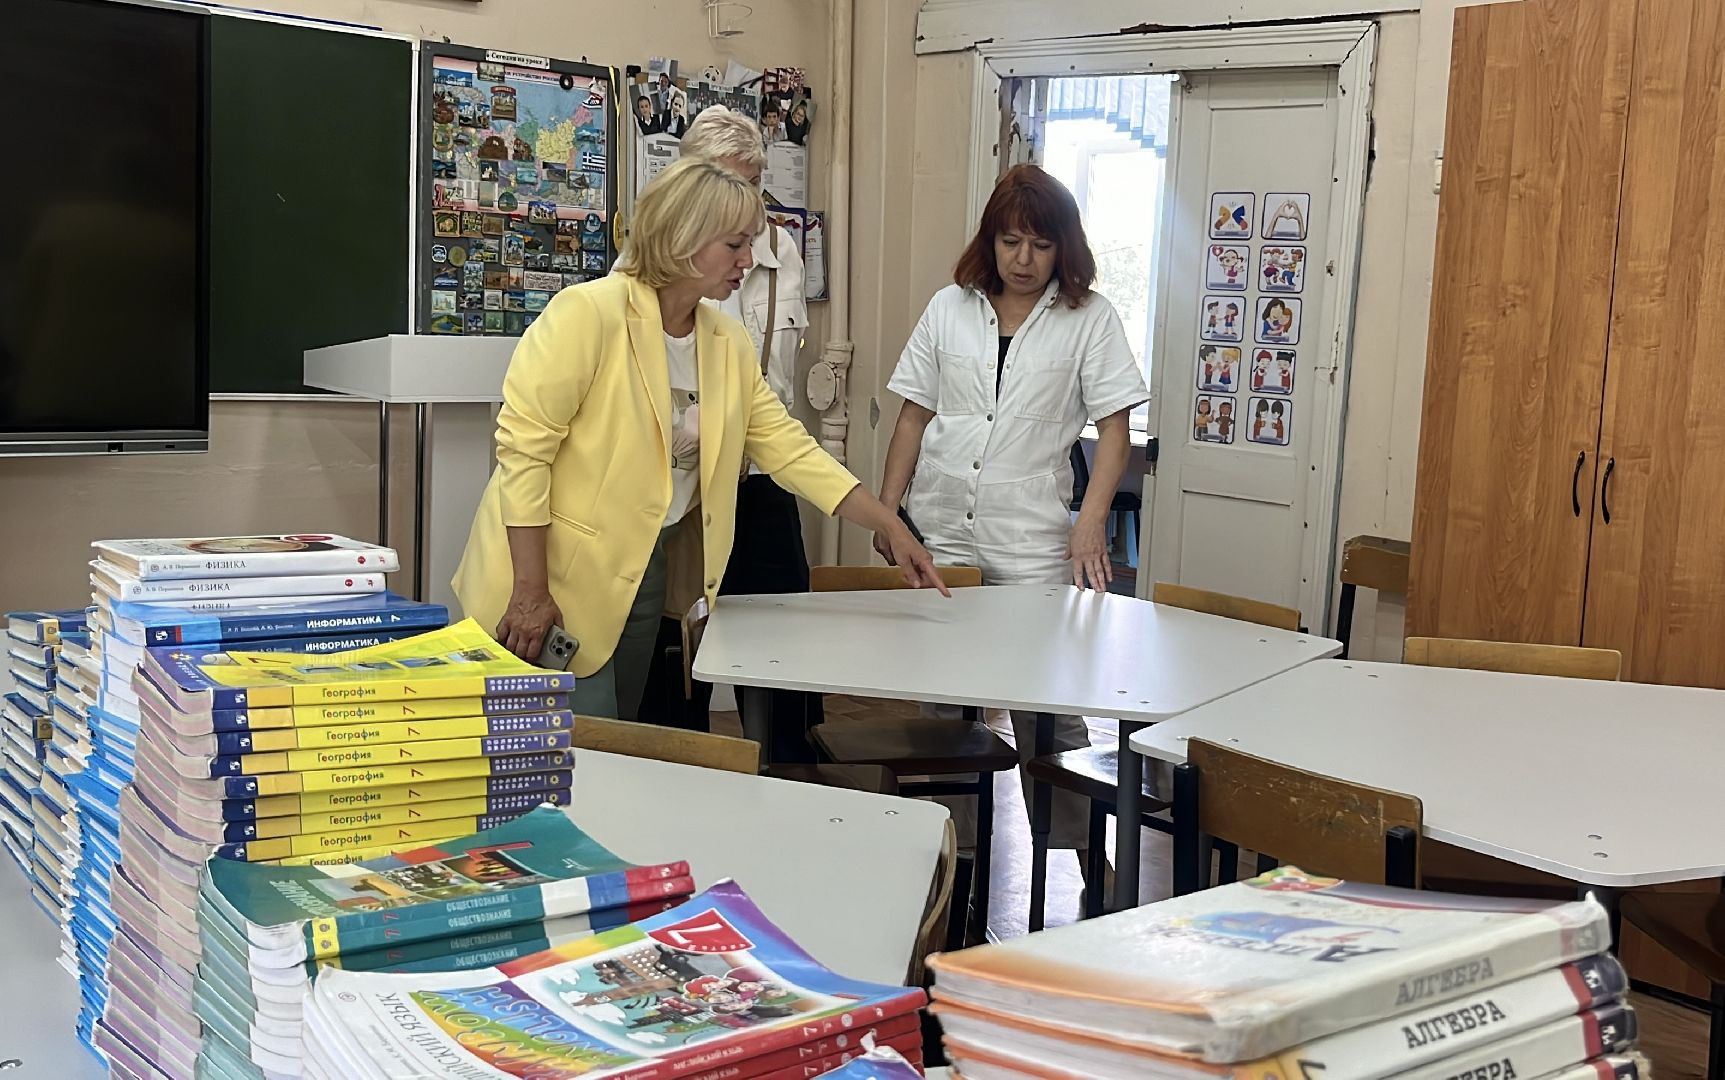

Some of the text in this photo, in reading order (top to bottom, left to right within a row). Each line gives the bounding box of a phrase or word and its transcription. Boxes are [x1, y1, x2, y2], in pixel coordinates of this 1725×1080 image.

[491, 52, 517, 61] Сегодня
[526, 58, 543, 66] уроке
[206, 560, 246, 569] ФИЗИКА
[189, 584, 230, 592] ФИЗИКА
[306, 616, 382, 628] ИНФОРМАТИКА
[306, 638, 380, 652] ИНФОРМАТИКА
[322, 685, 416, 698] География 7
[322, 706, 416, 718] География 7
[492, 717, 543, 725] ПОЛЯРНАЯ
[326, 727, 420, 740] География 7
[486, 737, 539, 745] ПОЛЯРНАЯ
[318, 748, 412, 763] География 7
[331, 768, 424, 783] География 7
[329, 788, 421, 805] География 7
[329, 809, 421, 826] География 7
[320, 830, 411, 847] География 7
[446, 894, 510, 912] ОБЩЕСТВОЗНАНИЕ
[448, 909, 512, 928] ОБЩЕСТВОЗНАНИЕ
[668, 922, 723, 944] 7
[456, 948, 518, 967] ОБЩЕСТВОЗНАНИЕ
[1396, 958, 1494, 1005] АЛГЕБРА
[375, 992, 422, 1032] ЯЗЫК
[804, 1026, 817, 1036] 7
[1401, 999, 1506, 1050] АЛГЕБРА
